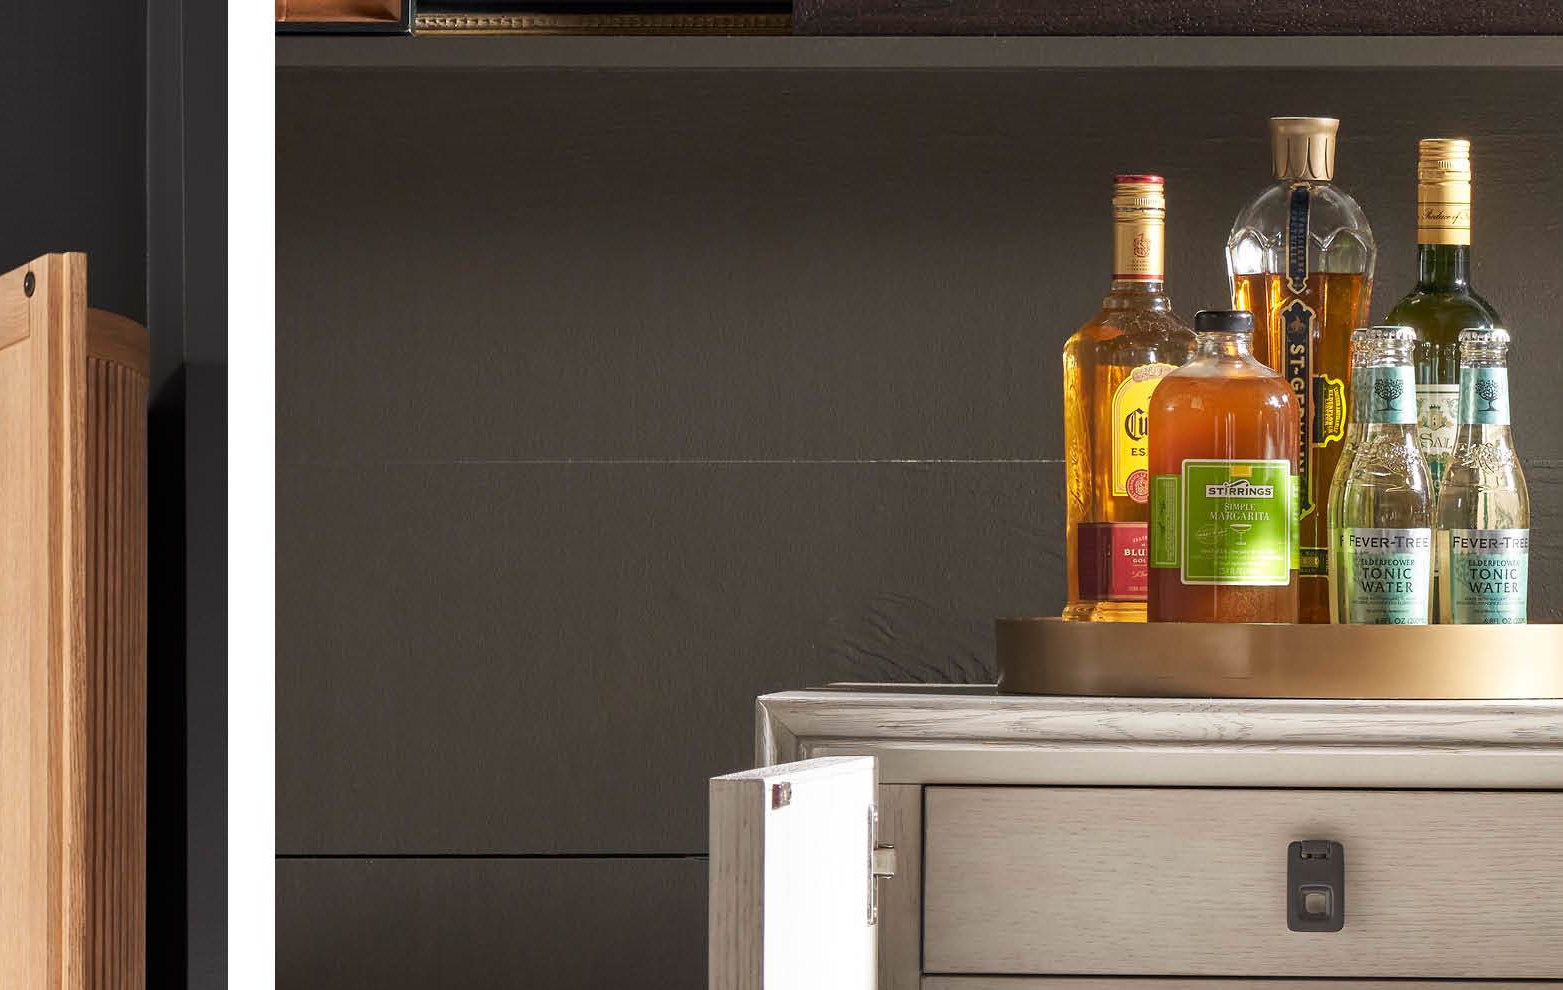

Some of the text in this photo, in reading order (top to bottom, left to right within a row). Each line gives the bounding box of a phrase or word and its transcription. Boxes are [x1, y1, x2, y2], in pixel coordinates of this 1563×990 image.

[1208, 486, 1272, 496] STIRRINGS
[1224, 503, 1256, 511] SIMPLE
[1209, 512, 1270, 521] MARGARITA
[1349, 535, 1429, 548] FEVER-TREE
[1453, 536, 1528, 549] FEVER-TREE
[1124, 548, 1147, 557] BLU
[1362, 568, 1412, 580] TONIC
[1470, 569, 1518, 580] TONIC
[1362, 582, 1413, 593] WATER
[1469, 582, 1518, 594] WATER
